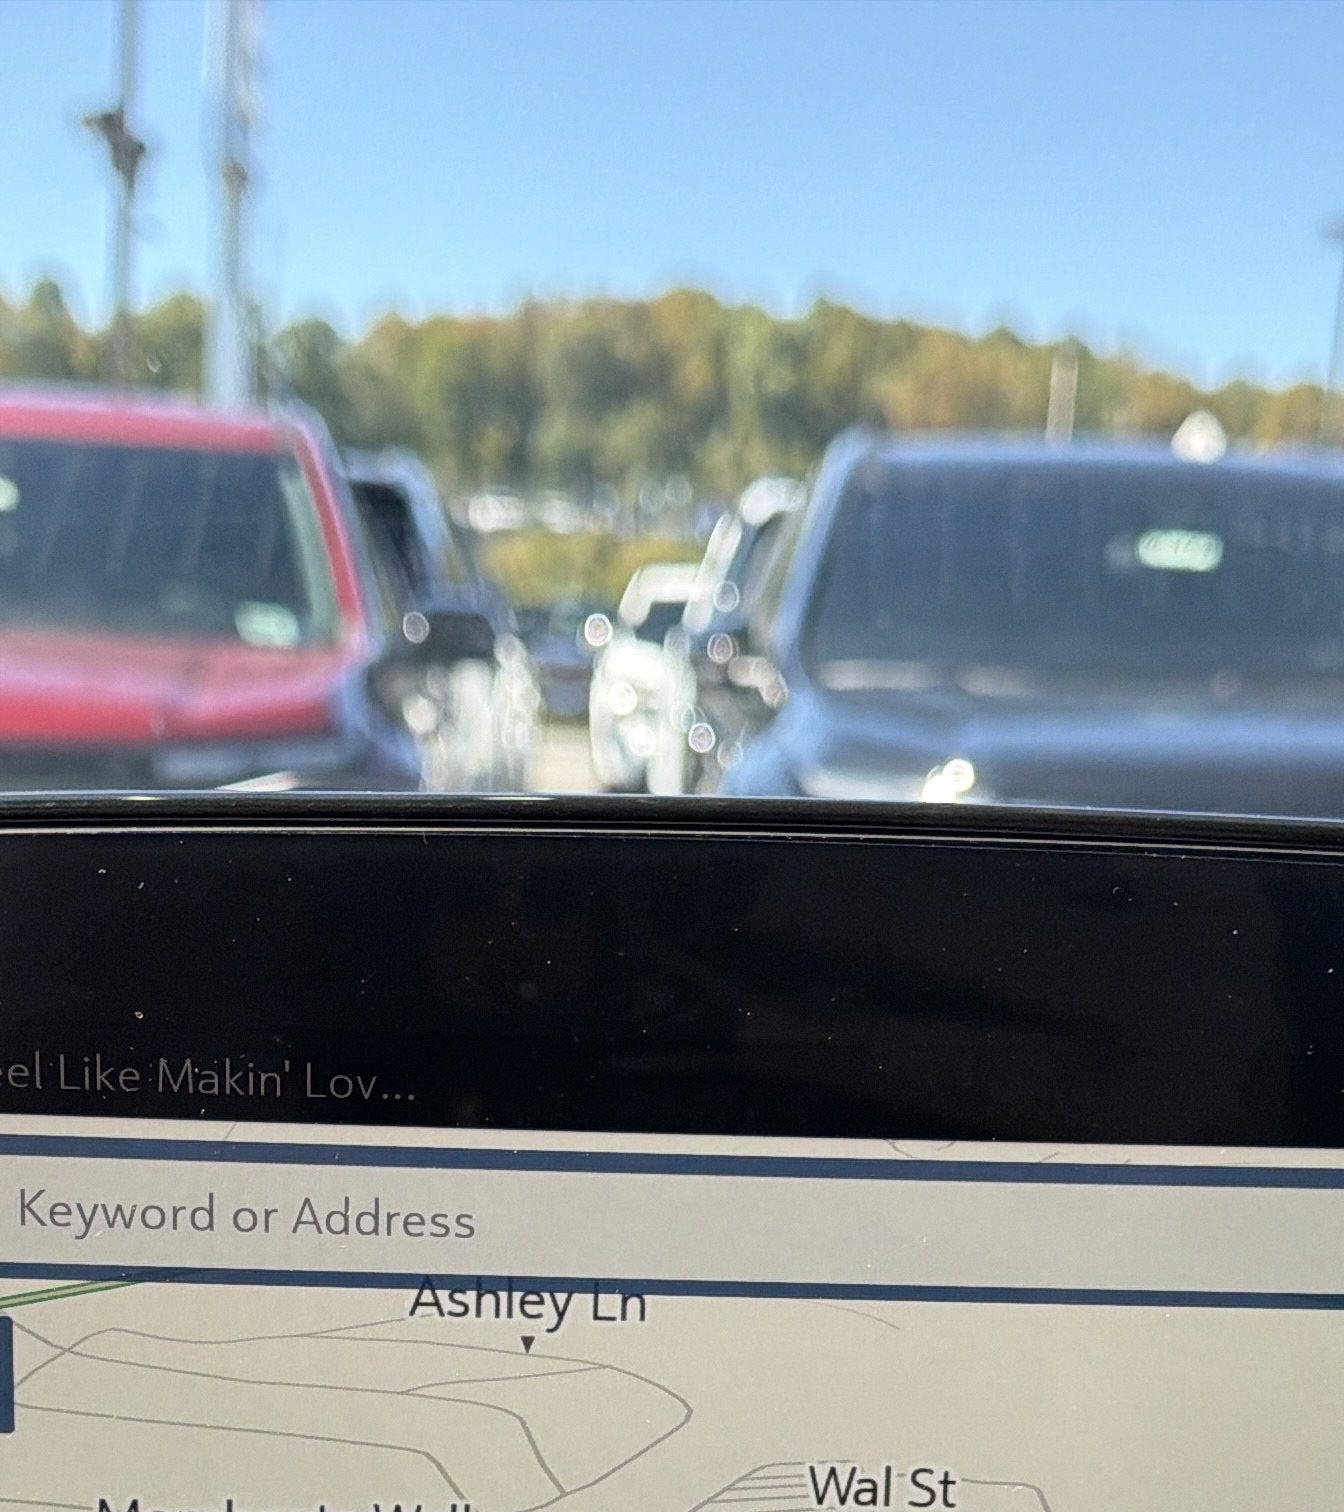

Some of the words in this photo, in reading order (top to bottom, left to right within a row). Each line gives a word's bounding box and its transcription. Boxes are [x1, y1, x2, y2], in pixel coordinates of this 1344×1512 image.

[59, 1053, 141, 1092] Like
[159, 1057, 290, 1097] Makin'
[19, 1188, 215, 1239] Keyword
[232, 1207, 278, 1233] or
[291, 1197, 476, 1240] Address
[409, 1275, 574, 1333] Ashley
[593, 1280, 646, 1322] Ln
[808, 1465, 892, 1507] Wal
[908, 1468, 957, 1508] St
